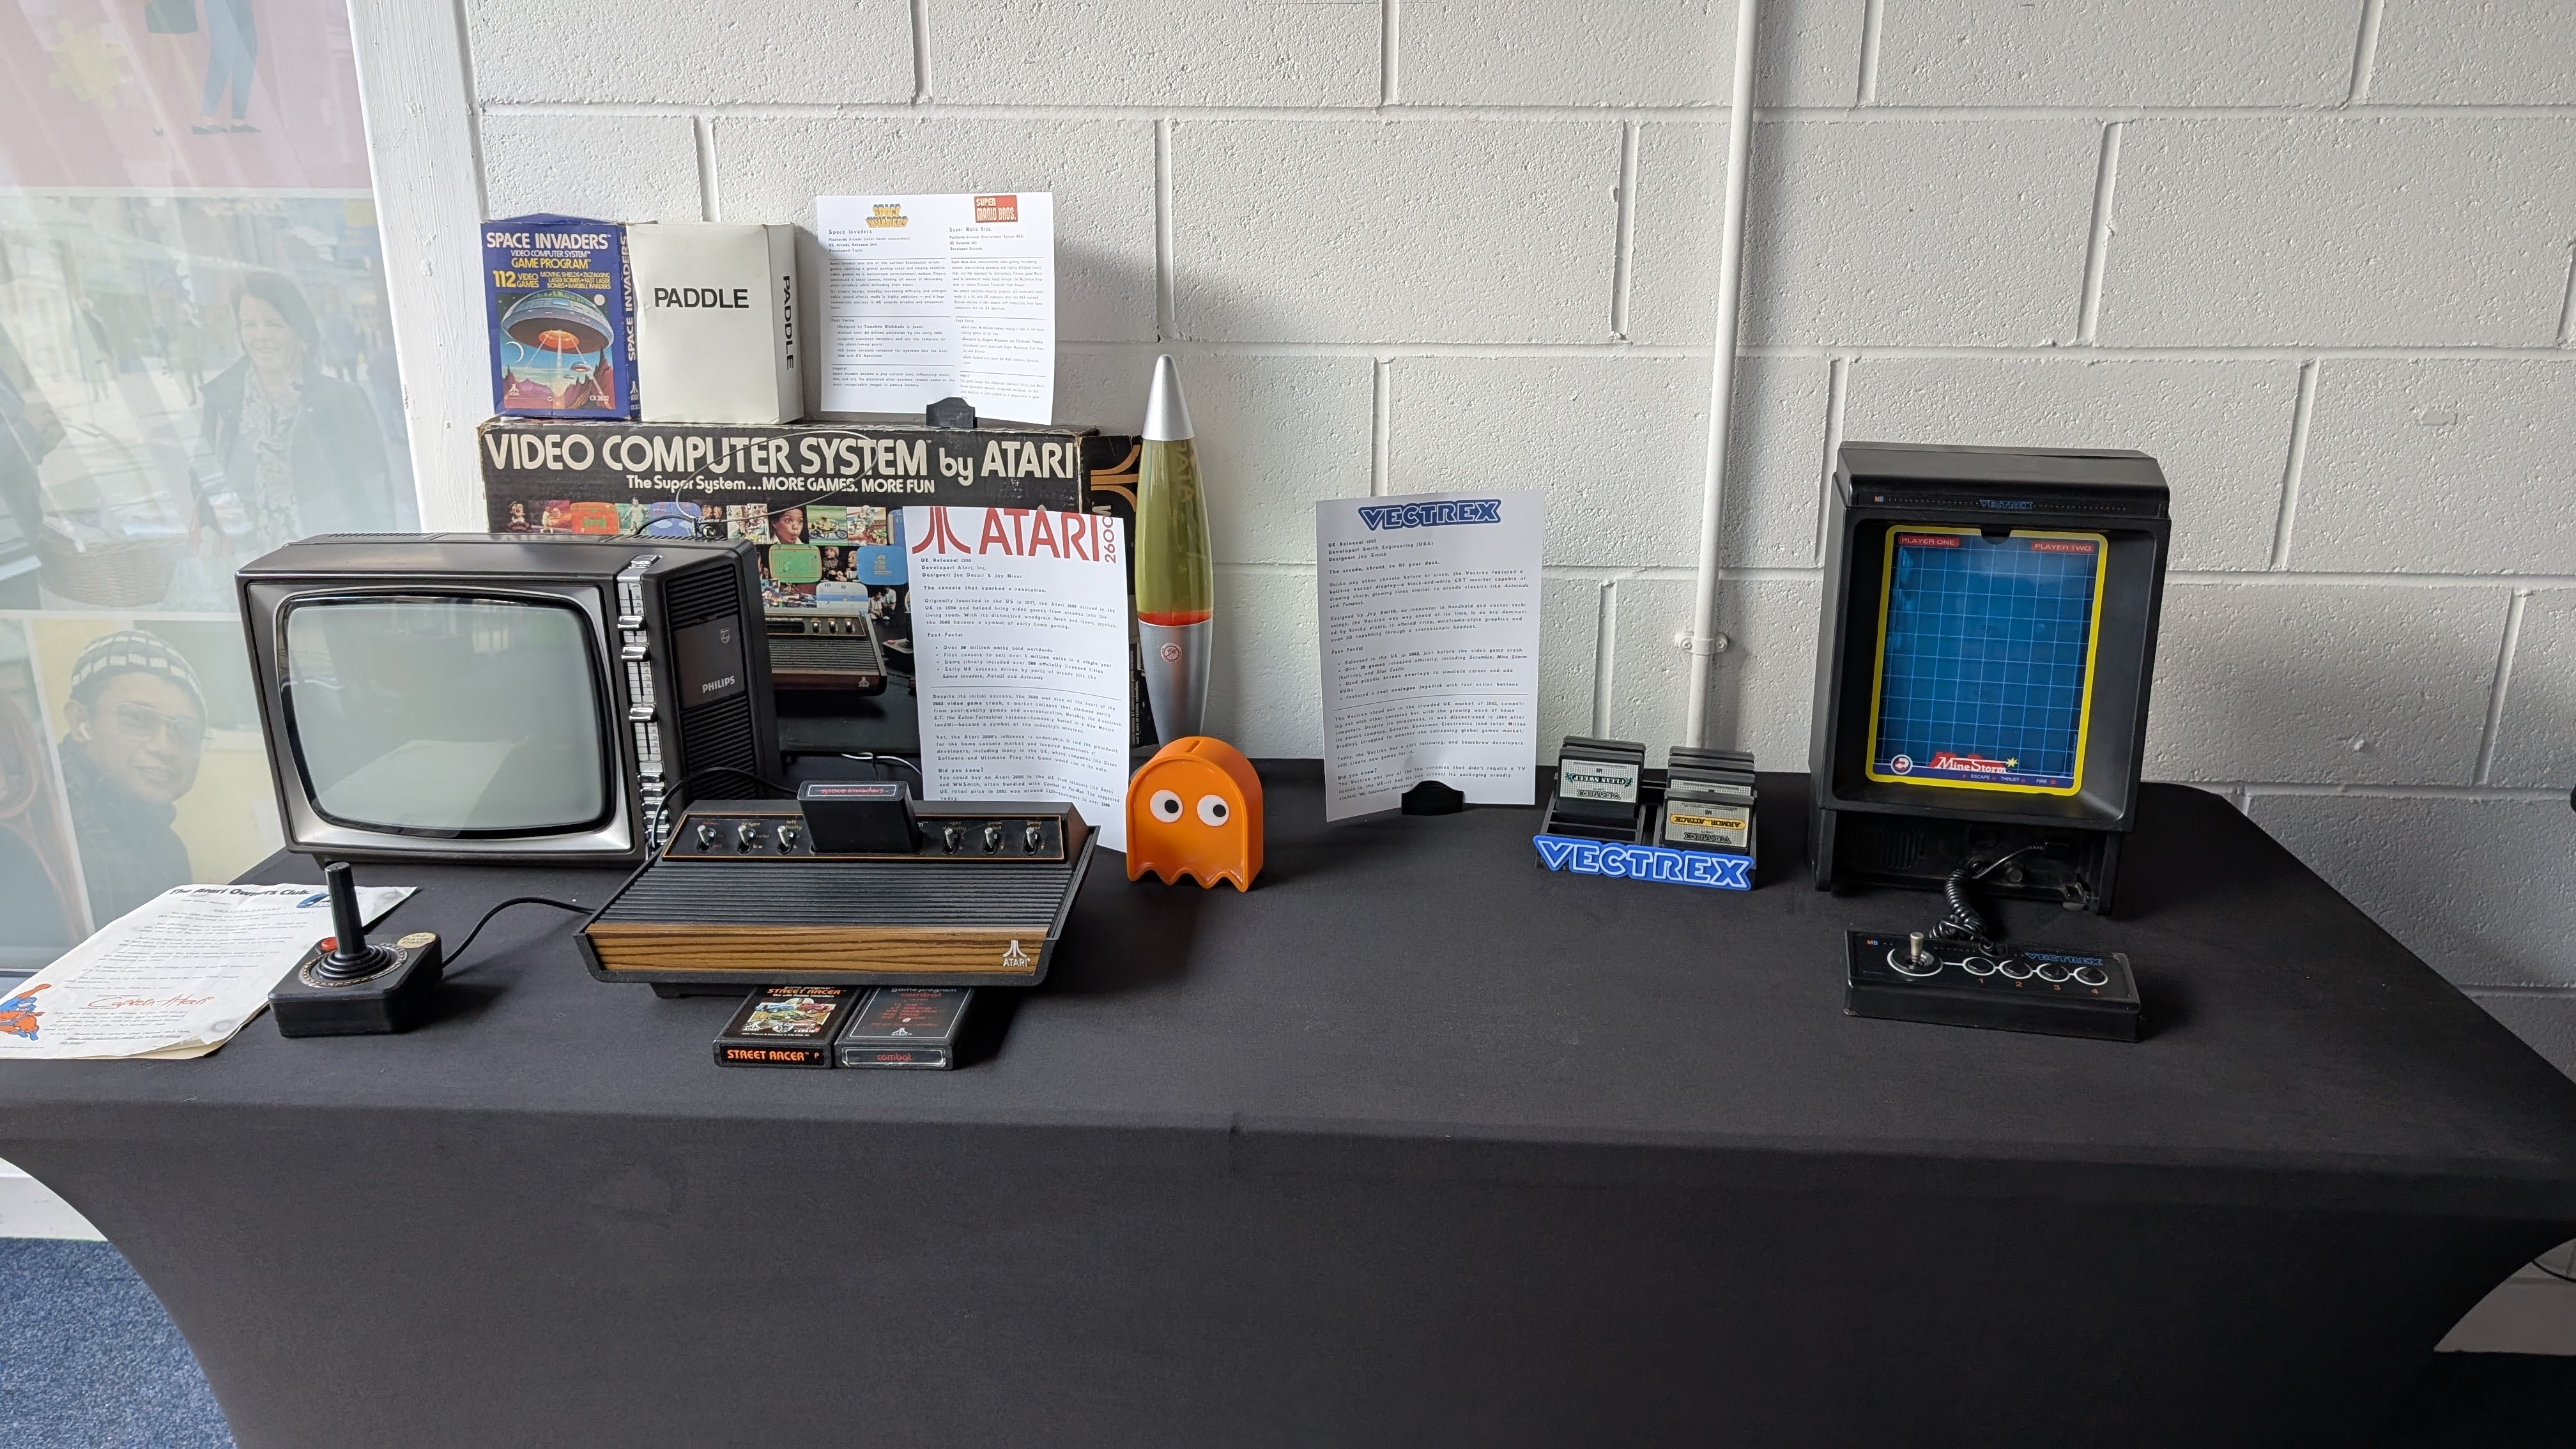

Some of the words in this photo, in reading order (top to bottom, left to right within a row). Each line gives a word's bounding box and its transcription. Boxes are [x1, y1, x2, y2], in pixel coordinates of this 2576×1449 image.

[976, 197, 996, 206] SUPER
[873, 203, 901, 217] SPACE
[976, 207, 997, 221] MARIO
[998, 207, 1016, 220] BROS.
[486, 232, 530, 249] SPACE
[512, 258, 539, 268] GAME
[540, 259, 588, 269] PROGRAM
[493, 270, 516, 288] 112
[654, 288, 749, 309] PADDLE
[783, 275, 794, 371] PADDLE
[626, 317, 636, 361] SPACE
[485, 434, 594, 471] VIDEO
[603, 435, 790, 474] COMPUTER
[801, 438, 928, 476] SYSTEM
[939, 448, 973, 486] by
[981, 440, 1073, 479] ATARI
[626, 475, 652, 489] The
[654, 476, 693, 493] Super
[807, 477, 858, 493] GAMES.
[862, 479, 904, 493] MORE
[907, 480, 935, 494] FUN
[1980, 499, 2033, 509] VECTREX
[1359, 500, 1501, 530] VECTREX
[979, 507, 1100, 562] ATARI
[1101, 514, 1116, 564] 2600
[703, 675, 735, 693] PHILIPS
[1577, 789, 1621, 799] VECTREX
[1675, 816, 1705, 825] ATTACK
[1683, 832, 1731, 844] VECTREX
[1535, 837, 1752, 889] VECTREX
[229, 888, 279, 896] Owners
[1003, 958, 1027, 967] ATARI
[2024, 952, 2103, 965] VECTREX
[88, 997, 155, 1008] Captain
[158, 993, 215, 1008] Atari
[727, 1049, 767, 1060] STREET
[769, 1050, 805, 1061] RACER
[877, 1052, 912, 1062] combat
